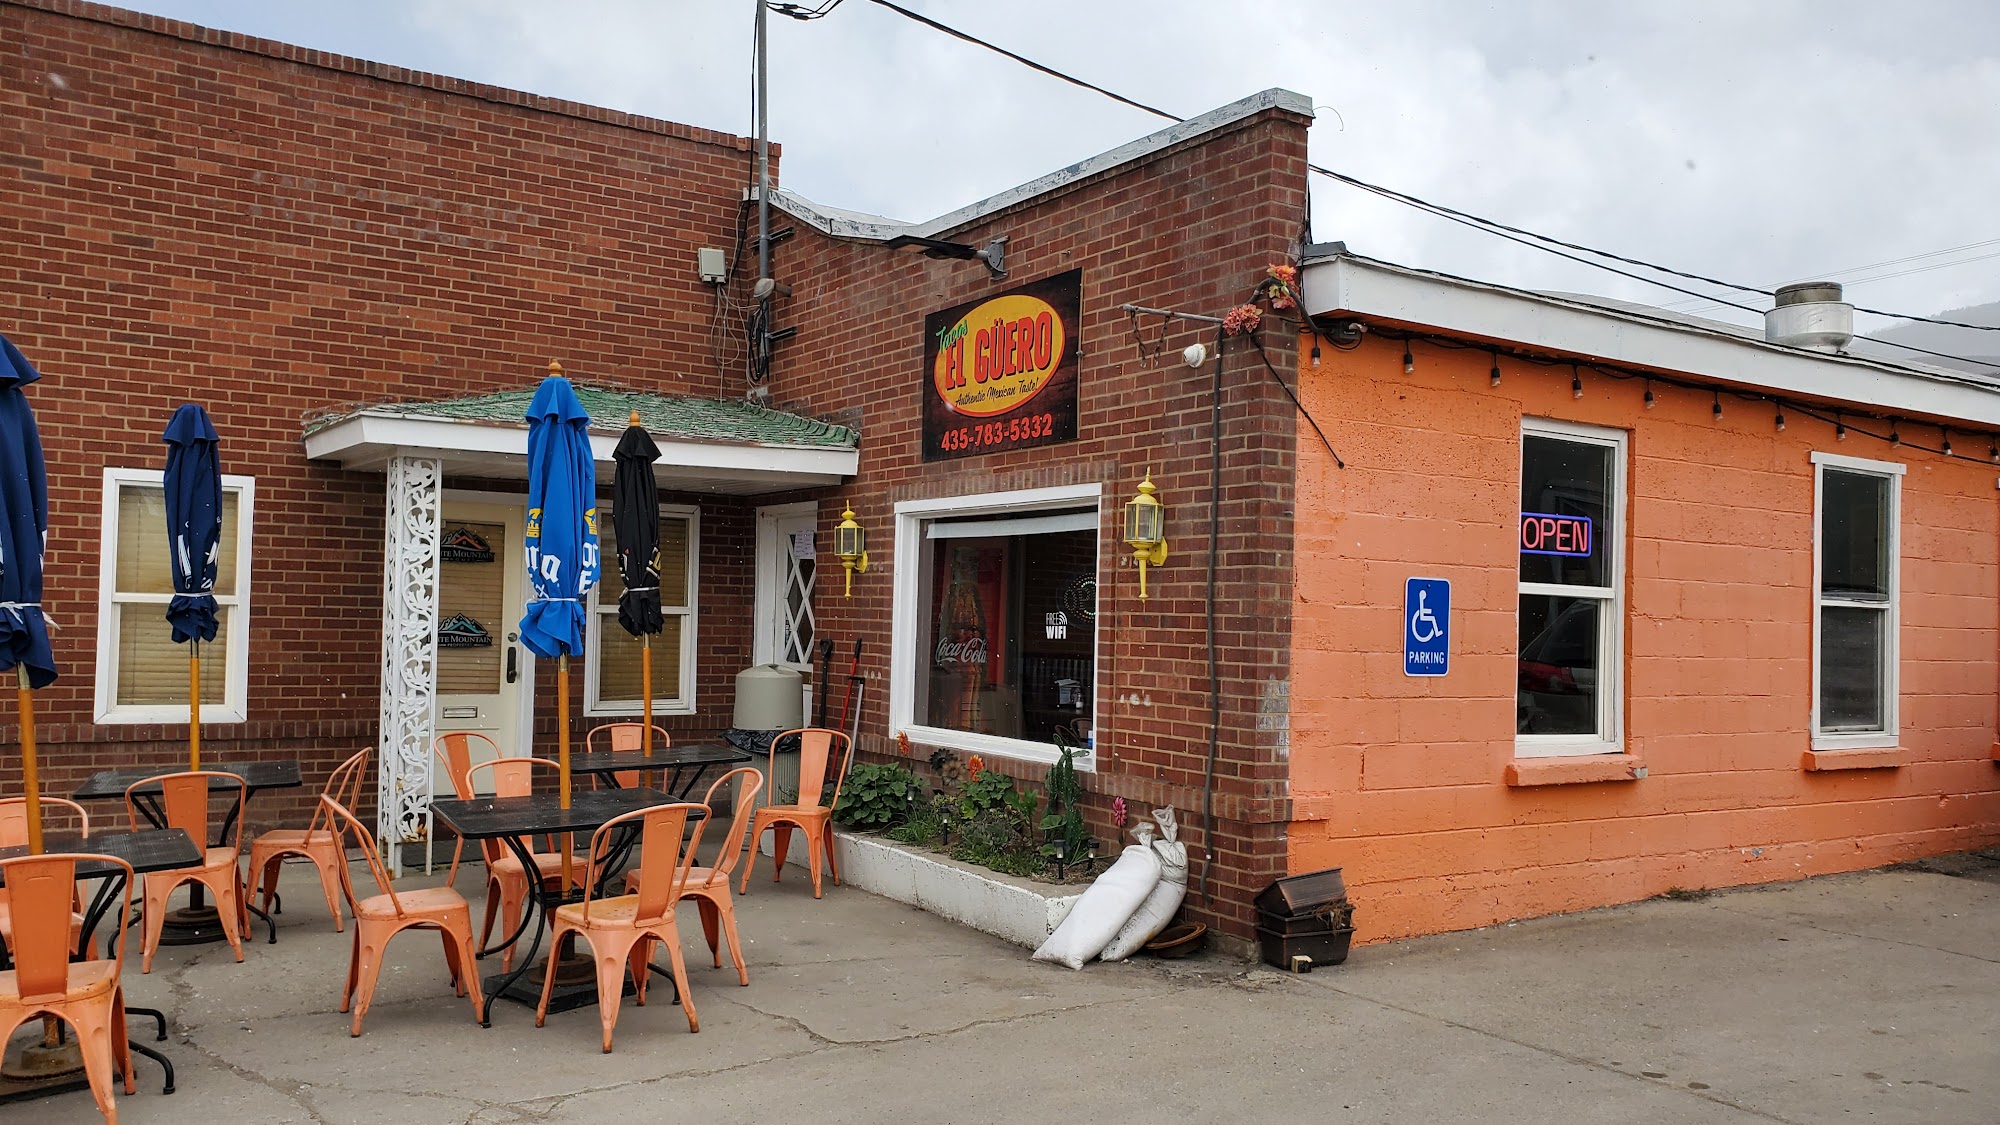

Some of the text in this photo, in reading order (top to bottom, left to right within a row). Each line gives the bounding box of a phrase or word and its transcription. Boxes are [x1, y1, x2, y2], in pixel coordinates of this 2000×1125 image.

[936, 319, 968, 354] Tacos
[946, 311, 1052, 391] EL GÜERO
[955, 376, 1039, 407] Authentic Mexican Taste!
[941, 413, 1053, 451] 435-783-5332
[1522, 517, 1588, 552] OPEN
[1045, 611, 1060, 625] FREE
[450, 635, 493, 643] MOUNTAIN
[1045, 625, 1066, 640] WIFI
[935, 637, 987, 663] Coca-Cola
[1409, 651, 1445, 665] PARKING
